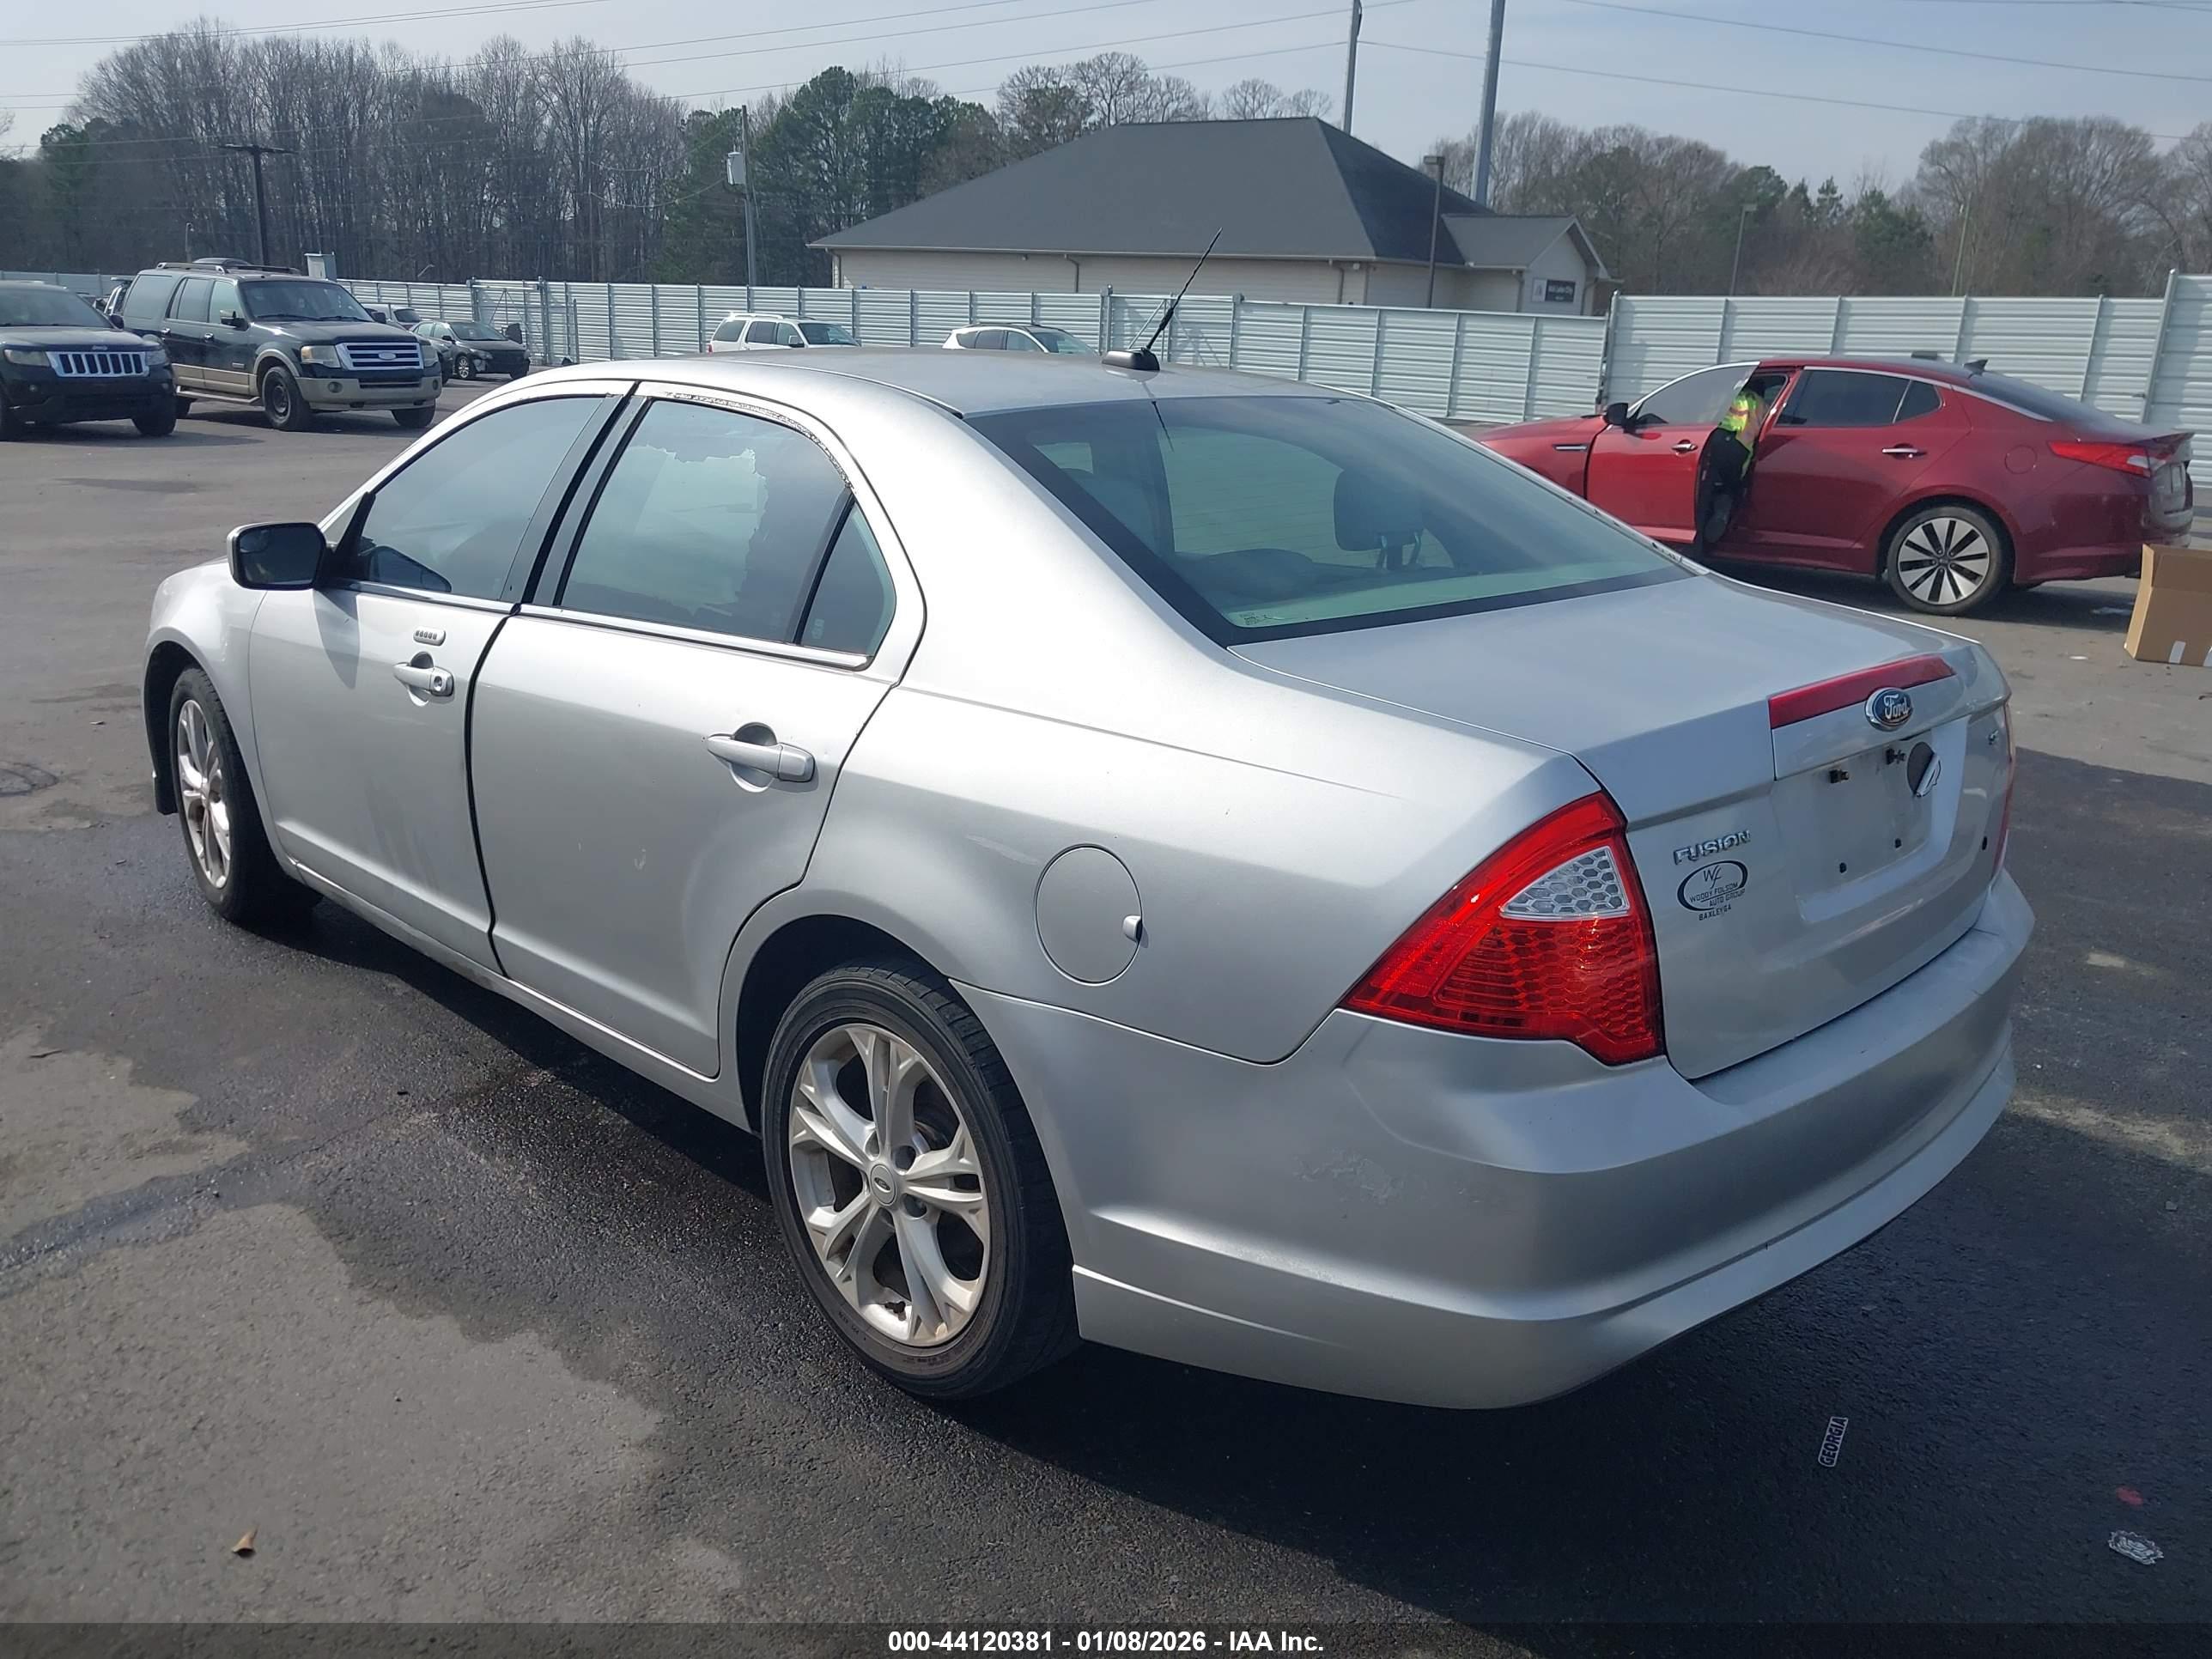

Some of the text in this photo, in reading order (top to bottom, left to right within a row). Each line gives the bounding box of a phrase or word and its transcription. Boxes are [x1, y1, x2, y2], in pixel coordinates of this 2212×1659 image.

[1883, 693, 1911, 720] Ford
[1673, 830, 1752, 866] FUSION
[1689, 881, 1738, 902] WOODY FOLSOM
[1709, 896, 1724, 908] AUTO
[1820, 1417, 1847, 1466] GEORGIA
